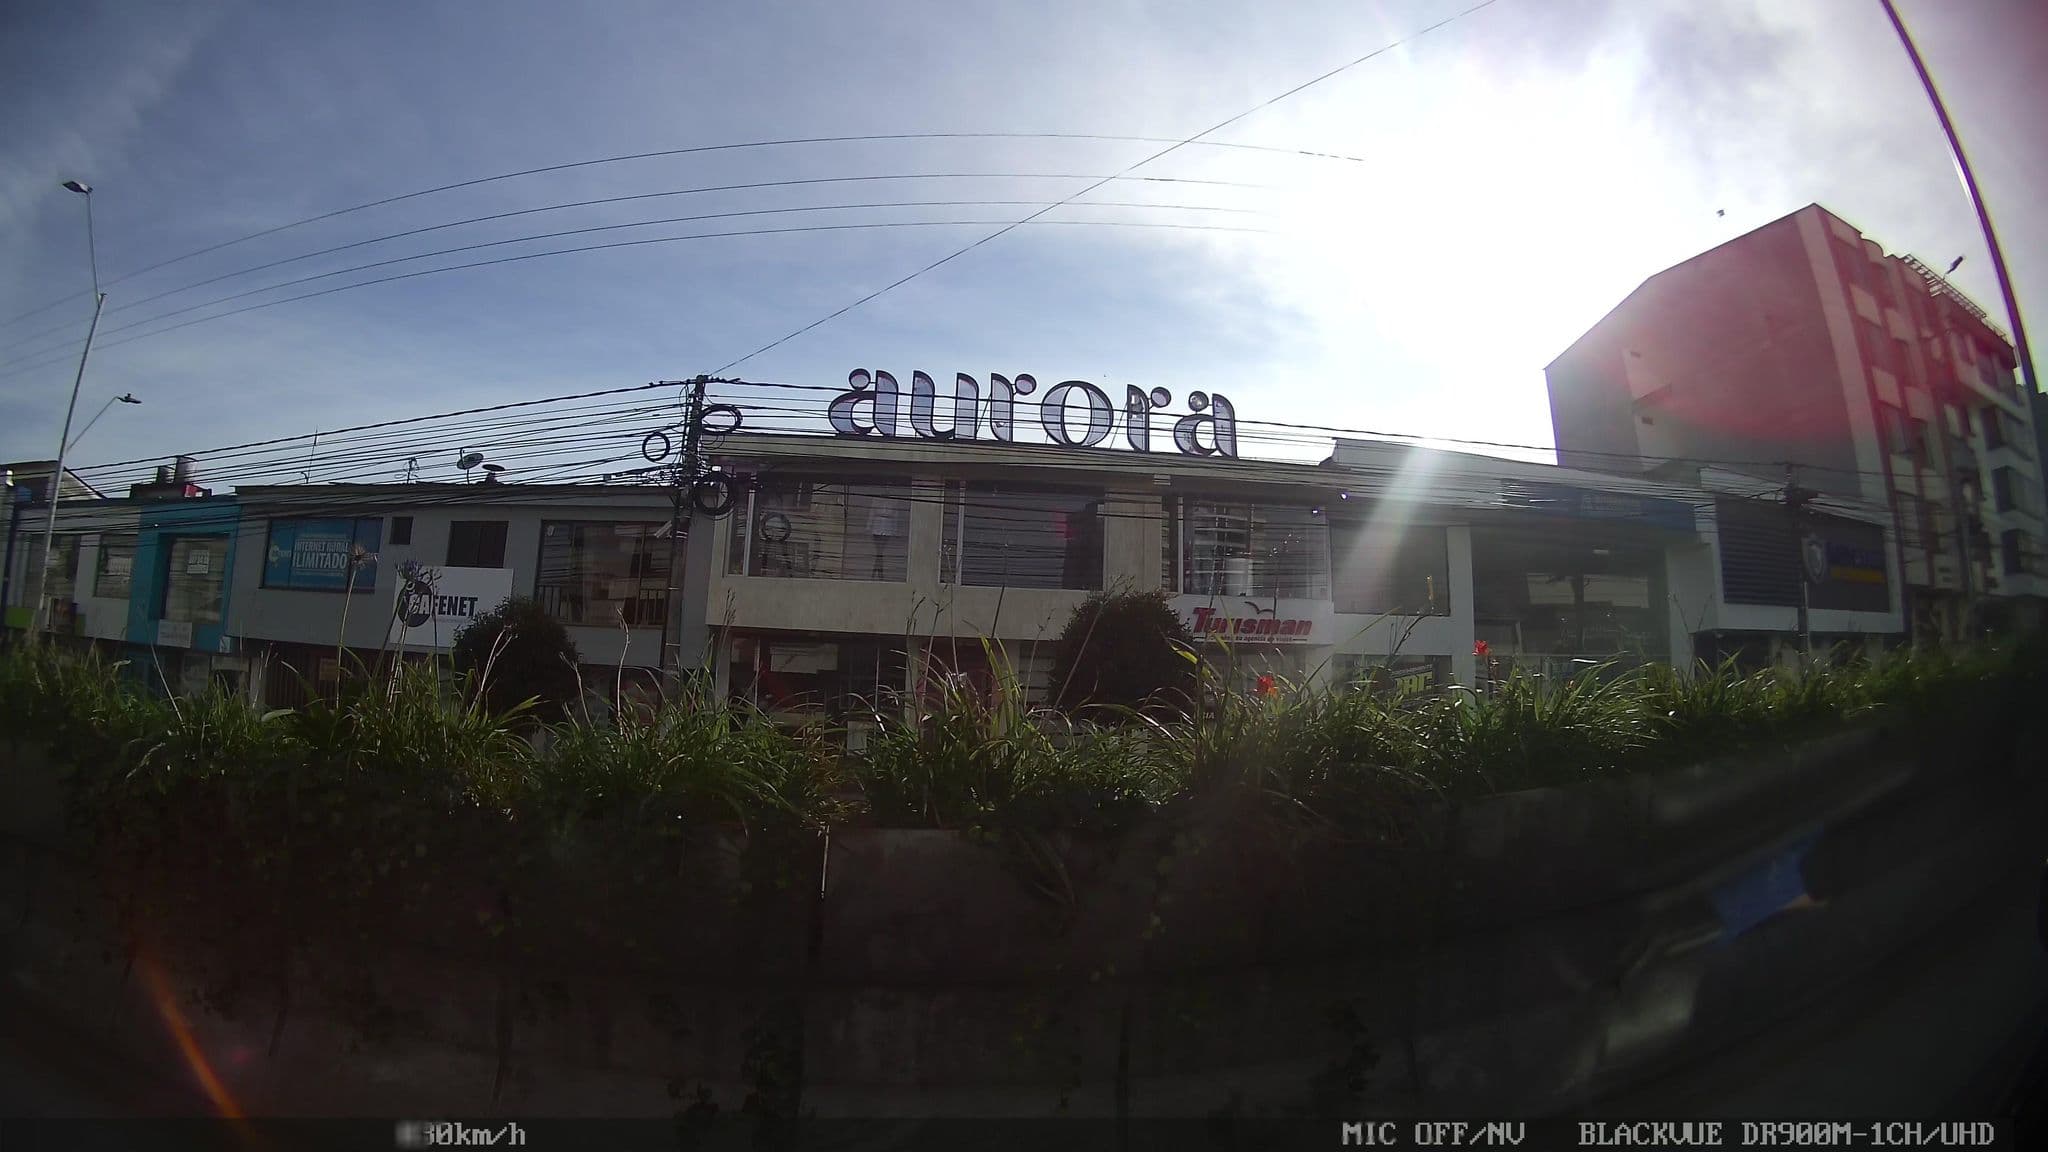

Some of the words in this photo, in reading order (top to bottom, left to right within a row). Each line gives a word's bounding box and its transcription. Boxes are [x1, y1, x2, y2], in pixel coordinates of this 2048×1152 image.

[828, 368, 1238, 457] aurora
[294, 541, 325, 552] INTERNET
[292, 552, 349, 569] ILIMITADO
